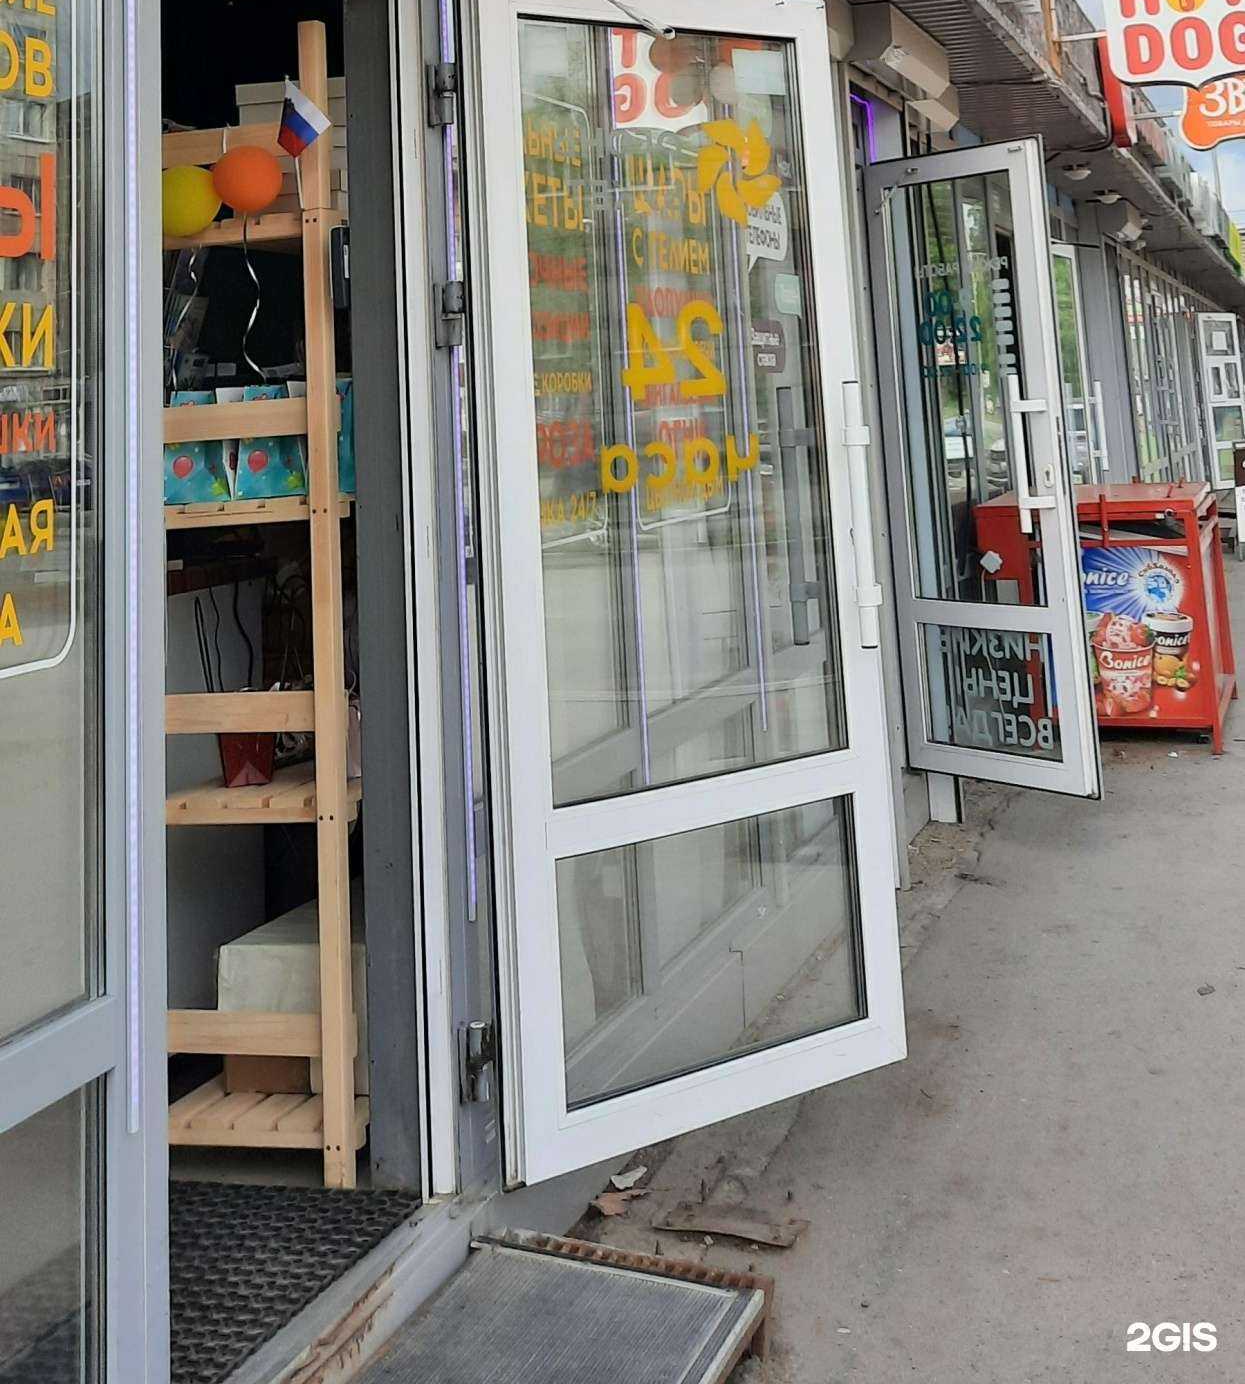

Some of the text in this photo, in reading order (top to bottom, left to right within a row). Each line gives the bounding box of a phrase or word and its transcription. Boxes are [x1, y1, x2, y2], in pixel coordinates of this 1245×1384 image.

[1124, 10, 1245, 75] DOG
[525, 171, 584, 233] ЕТЫ
[542, 372, 592, 396] КОРОБКИ
